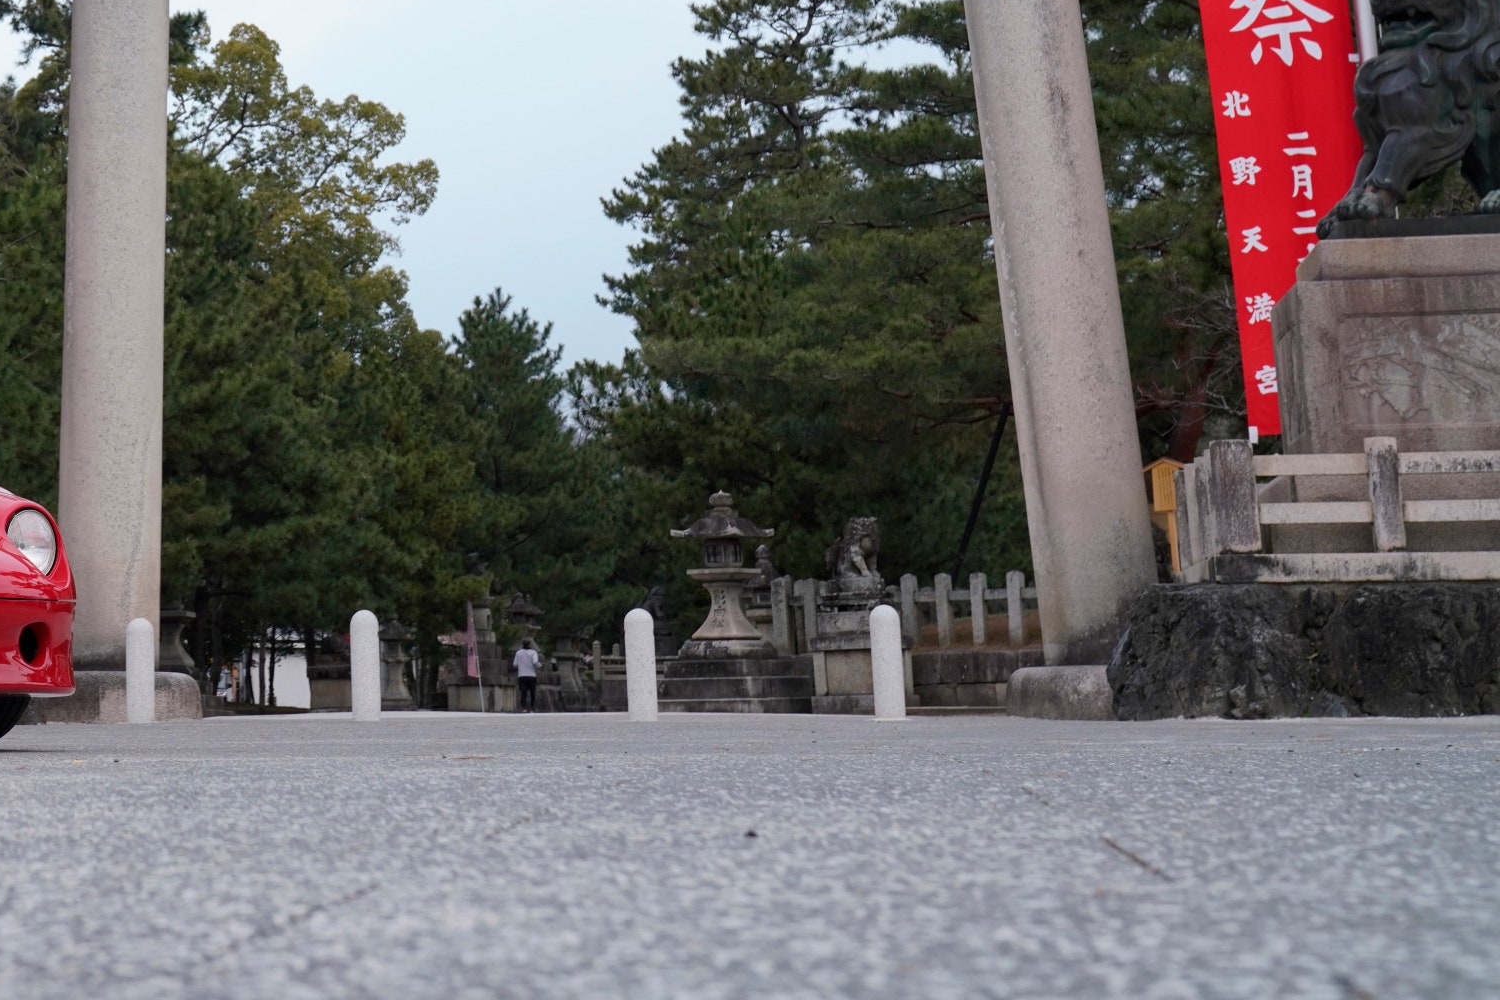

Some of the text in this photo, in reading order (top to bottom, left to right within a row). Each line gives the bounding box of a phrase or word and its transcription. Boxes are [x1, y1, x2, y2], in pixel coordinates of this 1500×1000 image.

[1221, 90, 1279, 395] 北野天満宮
[1282, 131, 1317, 262] 二月二
